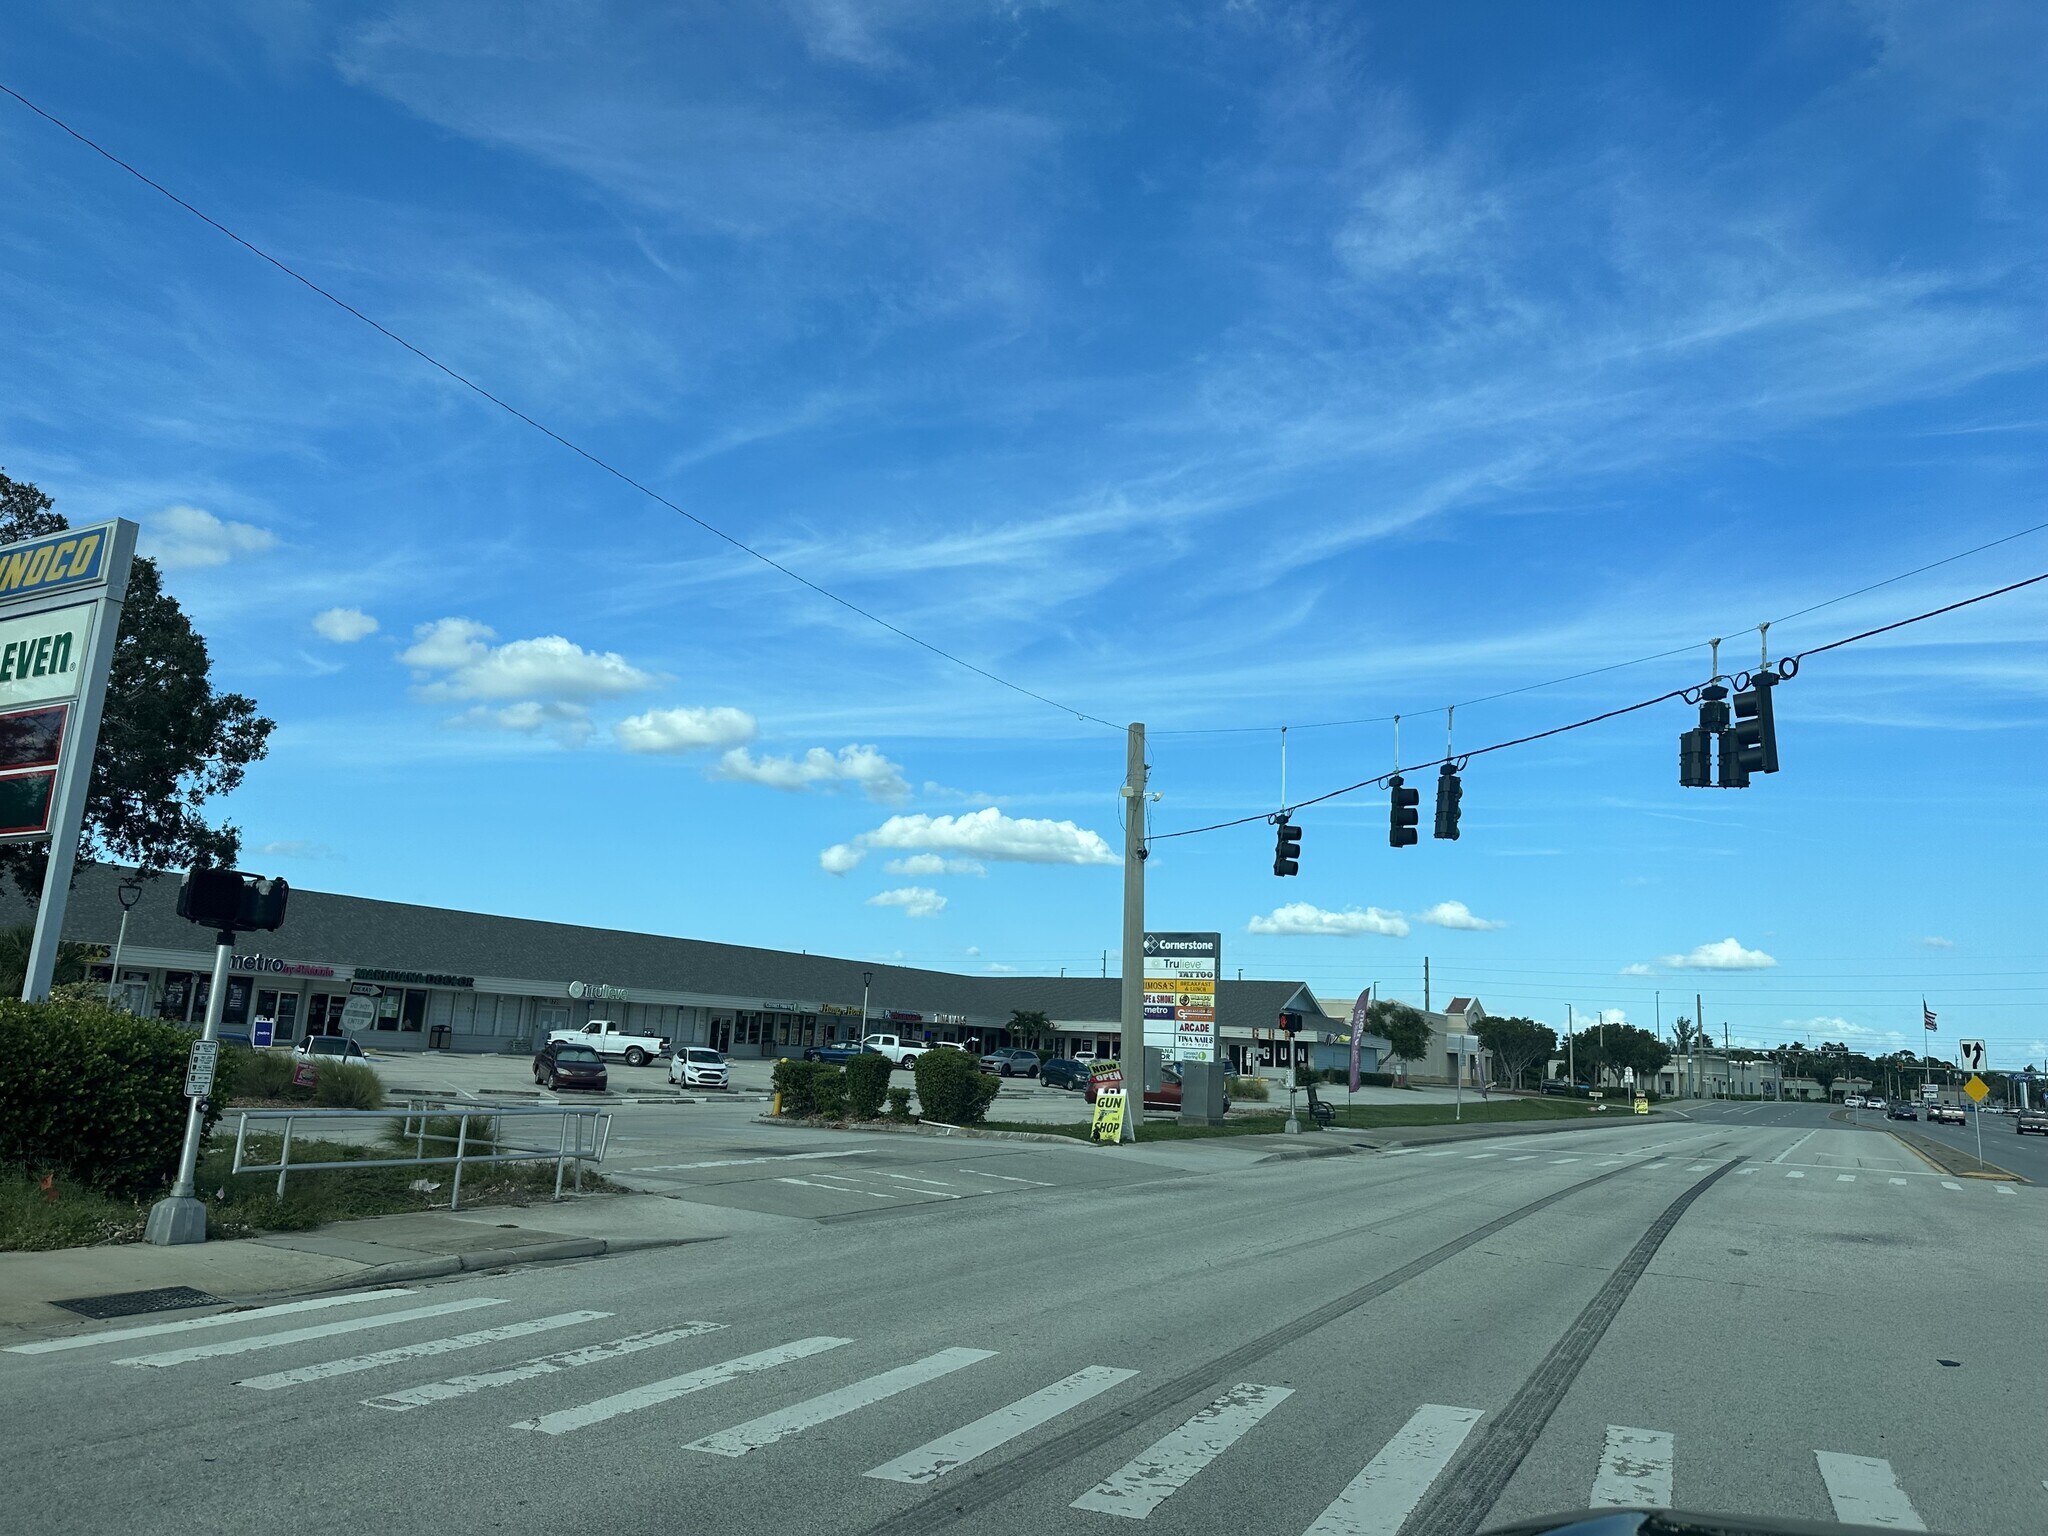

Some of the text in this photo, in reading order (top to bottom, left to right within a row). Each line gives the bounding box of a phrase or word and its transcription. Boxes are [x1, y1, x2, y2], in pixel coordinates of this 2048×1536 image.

[1160, 940, 1213, 950] Cornerstone
[230, 953, 284, 972] metro
[1164, 959, 1201, 969] Trulieve
[1157, 995, 1174, 1004] SMOKE
[1144, 1006, 1168, 1014] metro
[1179, 1023, 1210, 1033] ARCADE
[1194, 1036, 1213, 1044] NAILS
[1092, 1063, 1117, 1074] NOW
[1095, 1070, 1122, 1081] OPEN
[1097, 1097, 1122, 1109] GUN
[1094, 1122, 1120, 1134] SHOP
